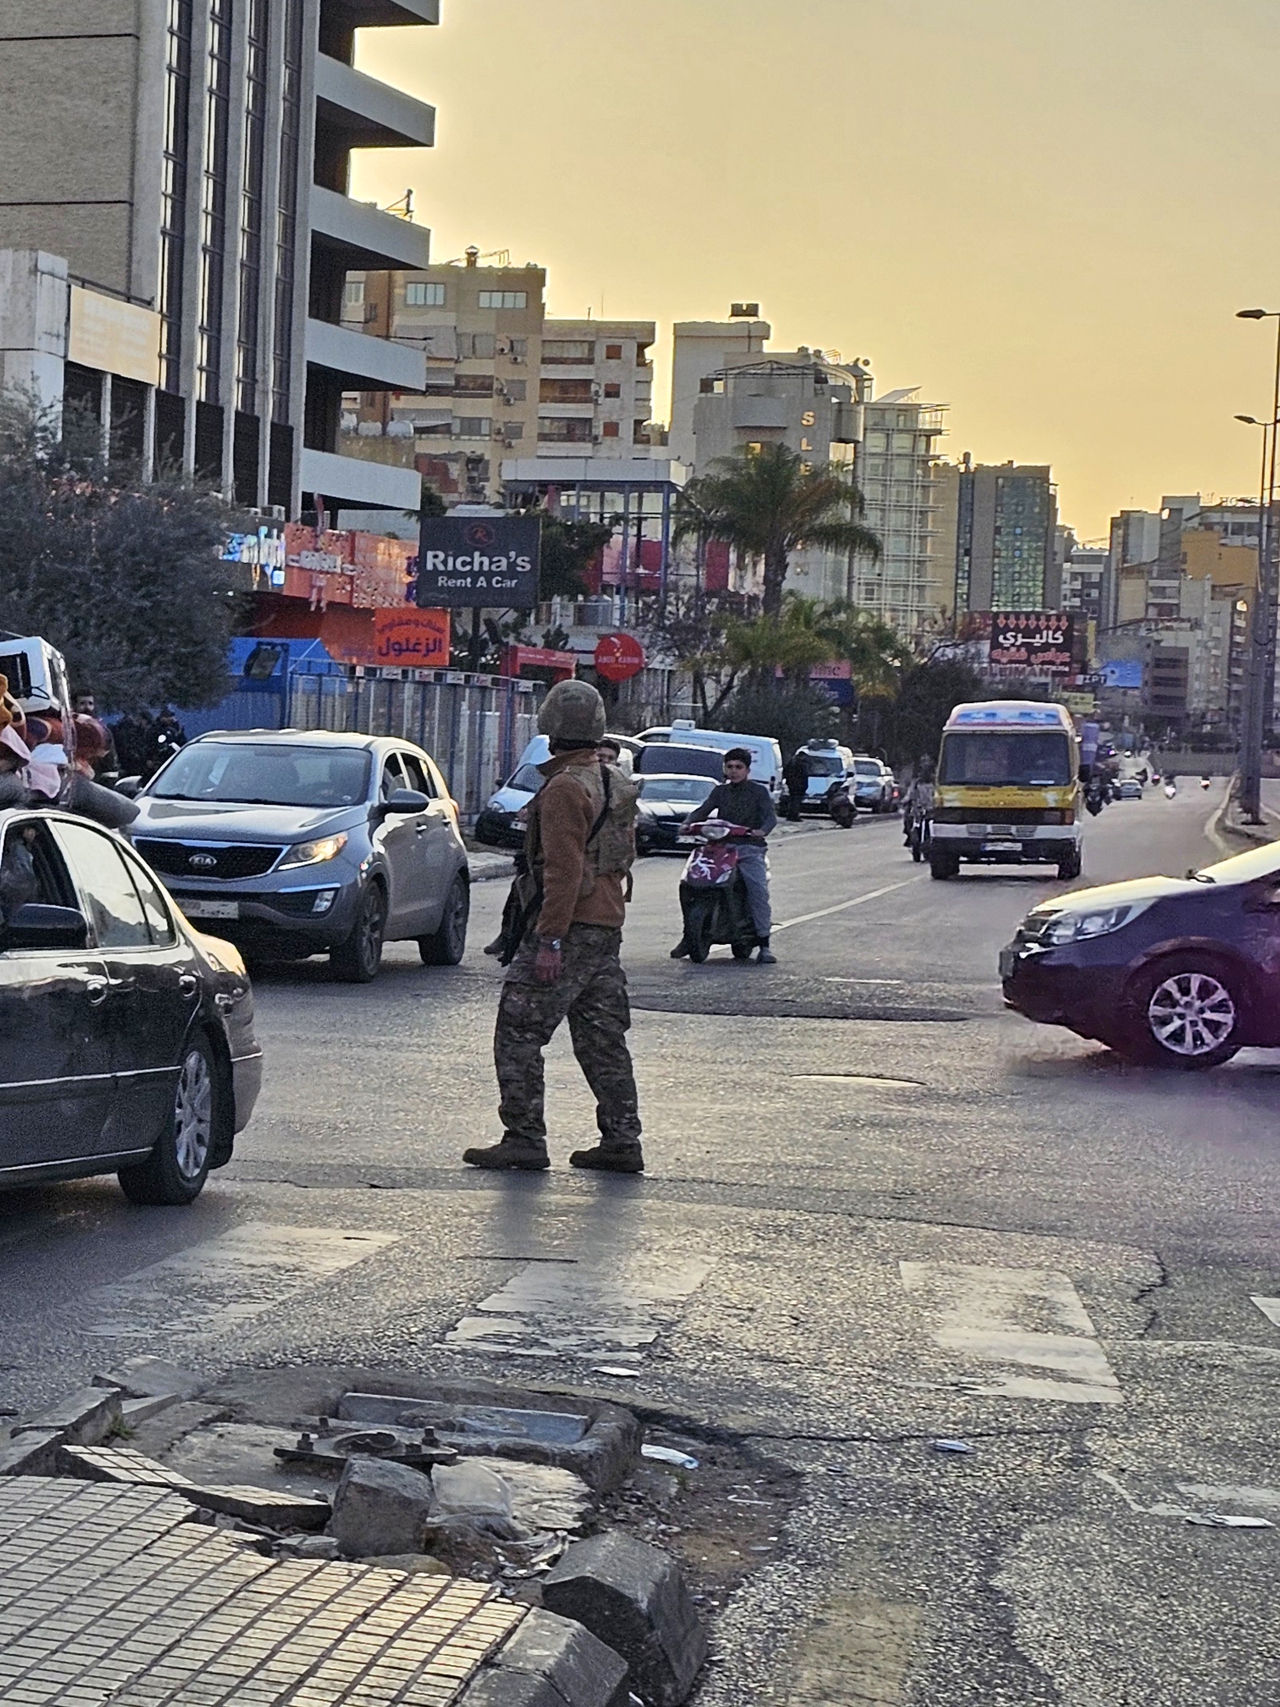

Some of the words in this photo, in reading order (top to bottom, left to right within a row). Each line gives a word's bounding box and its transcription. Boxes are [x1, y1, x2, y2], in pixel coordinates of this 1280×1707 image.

[425, 550, 532, 572] Richa's
[437, 575, 472, 588] Rent
[476, 576, 487, 588] A
[491, 576, 518, 588] Car
[997, 630, 1064, 648] كاليري
[377, 637, 442, 657] الزغلول
[1083, 675, 1106, 685] IPT
[192, 856, 211, 865] KIA
